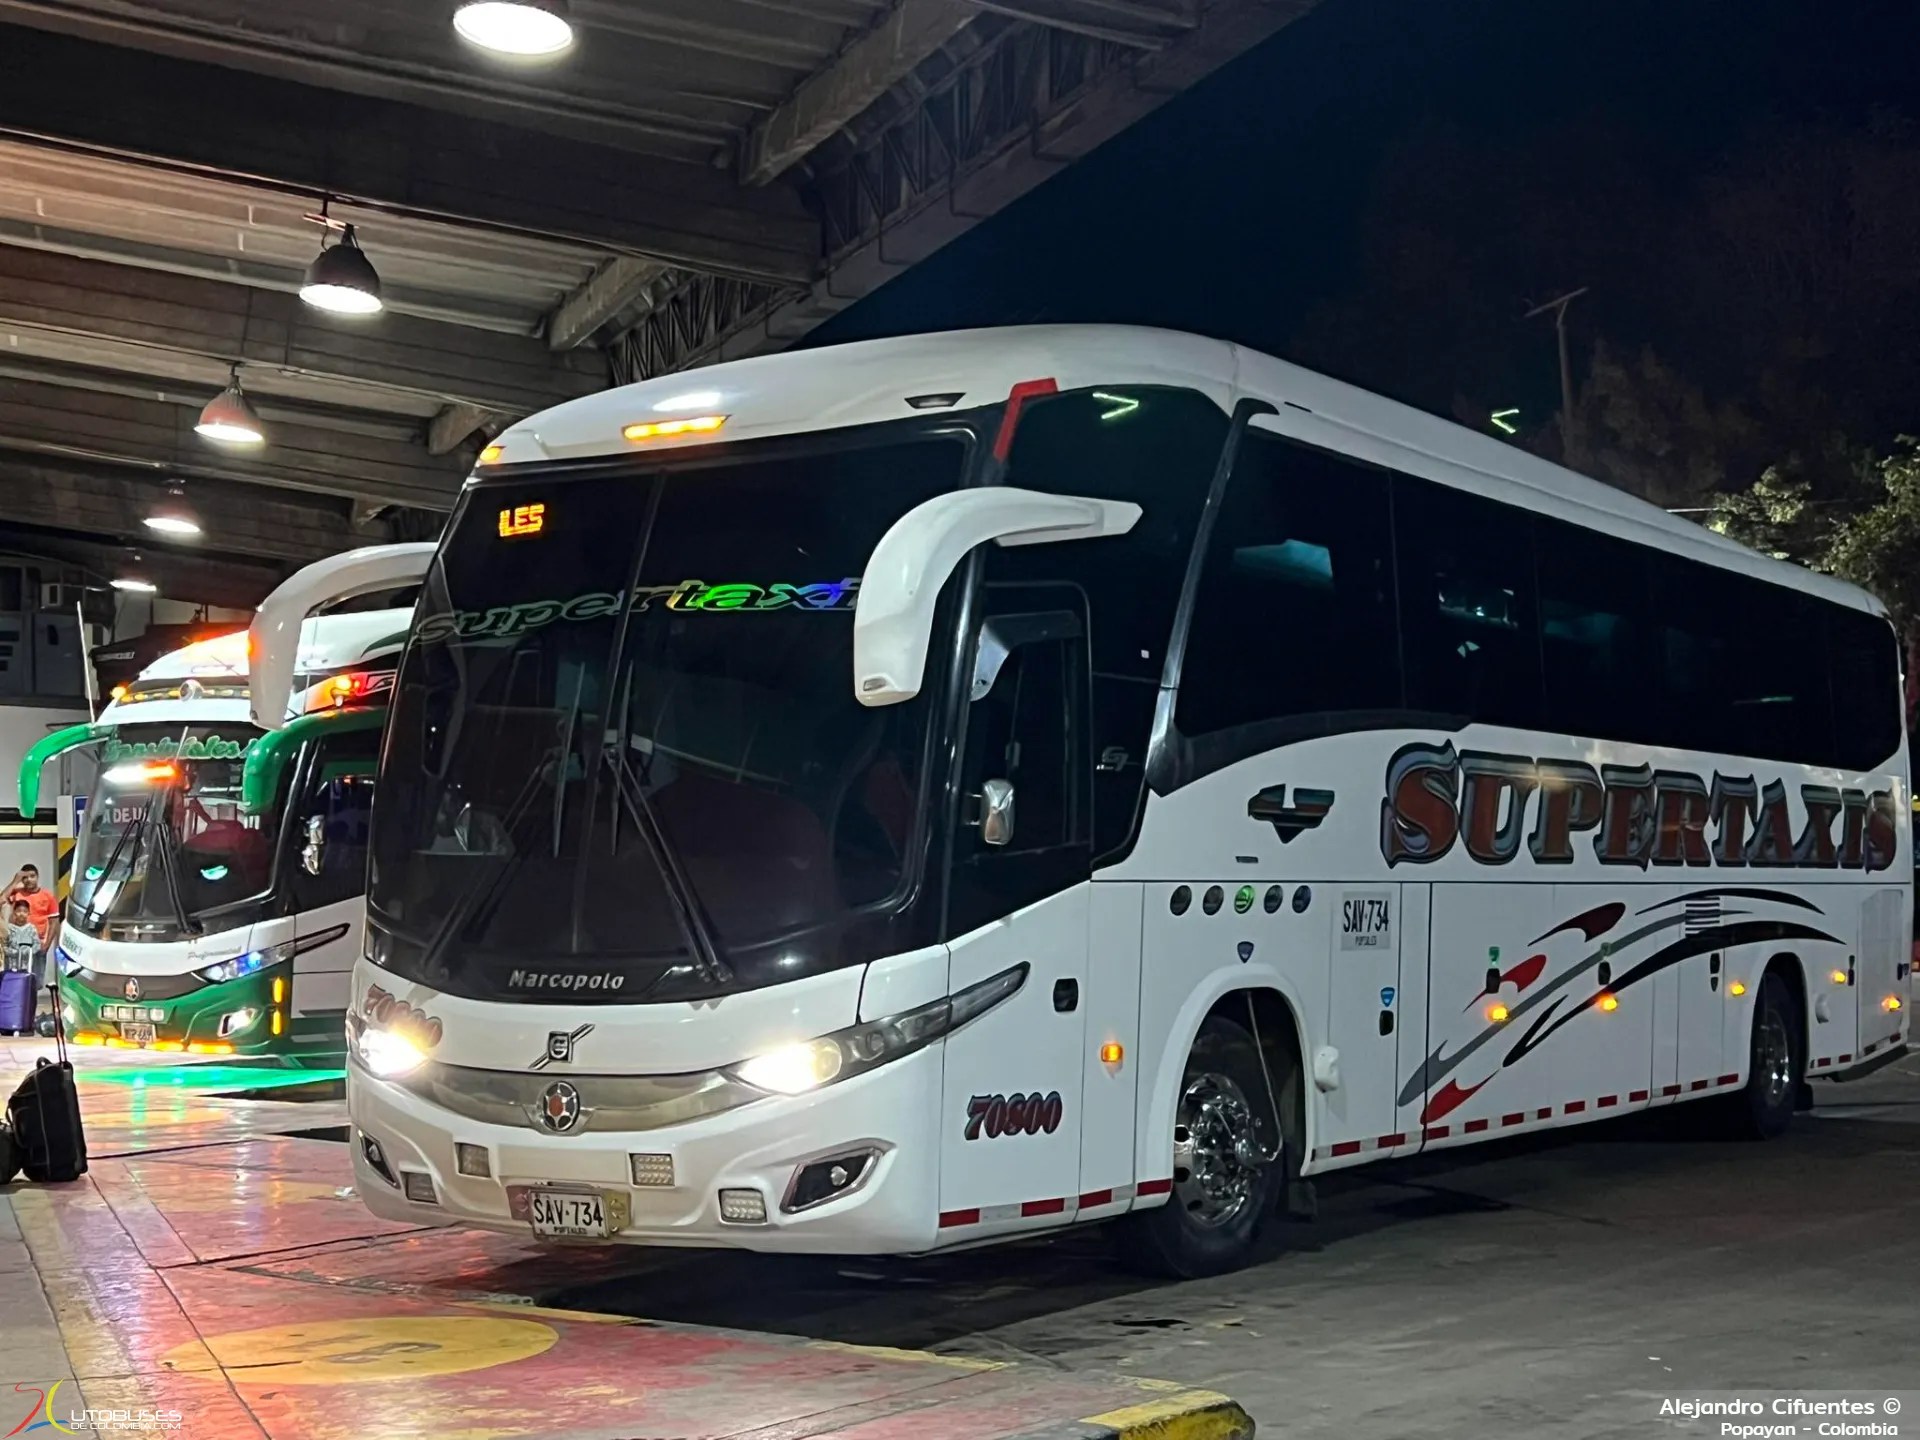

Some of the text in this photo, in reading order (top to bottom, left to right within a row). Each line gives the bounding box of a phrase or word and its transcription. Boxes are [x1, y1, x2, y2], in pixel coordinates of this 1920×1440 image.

[1380, 738, 1898, 874] SUPERTAXIS
[508, 969, 625, 991] Marcopolo
[964, 1090, 1063, 1141] 70800
